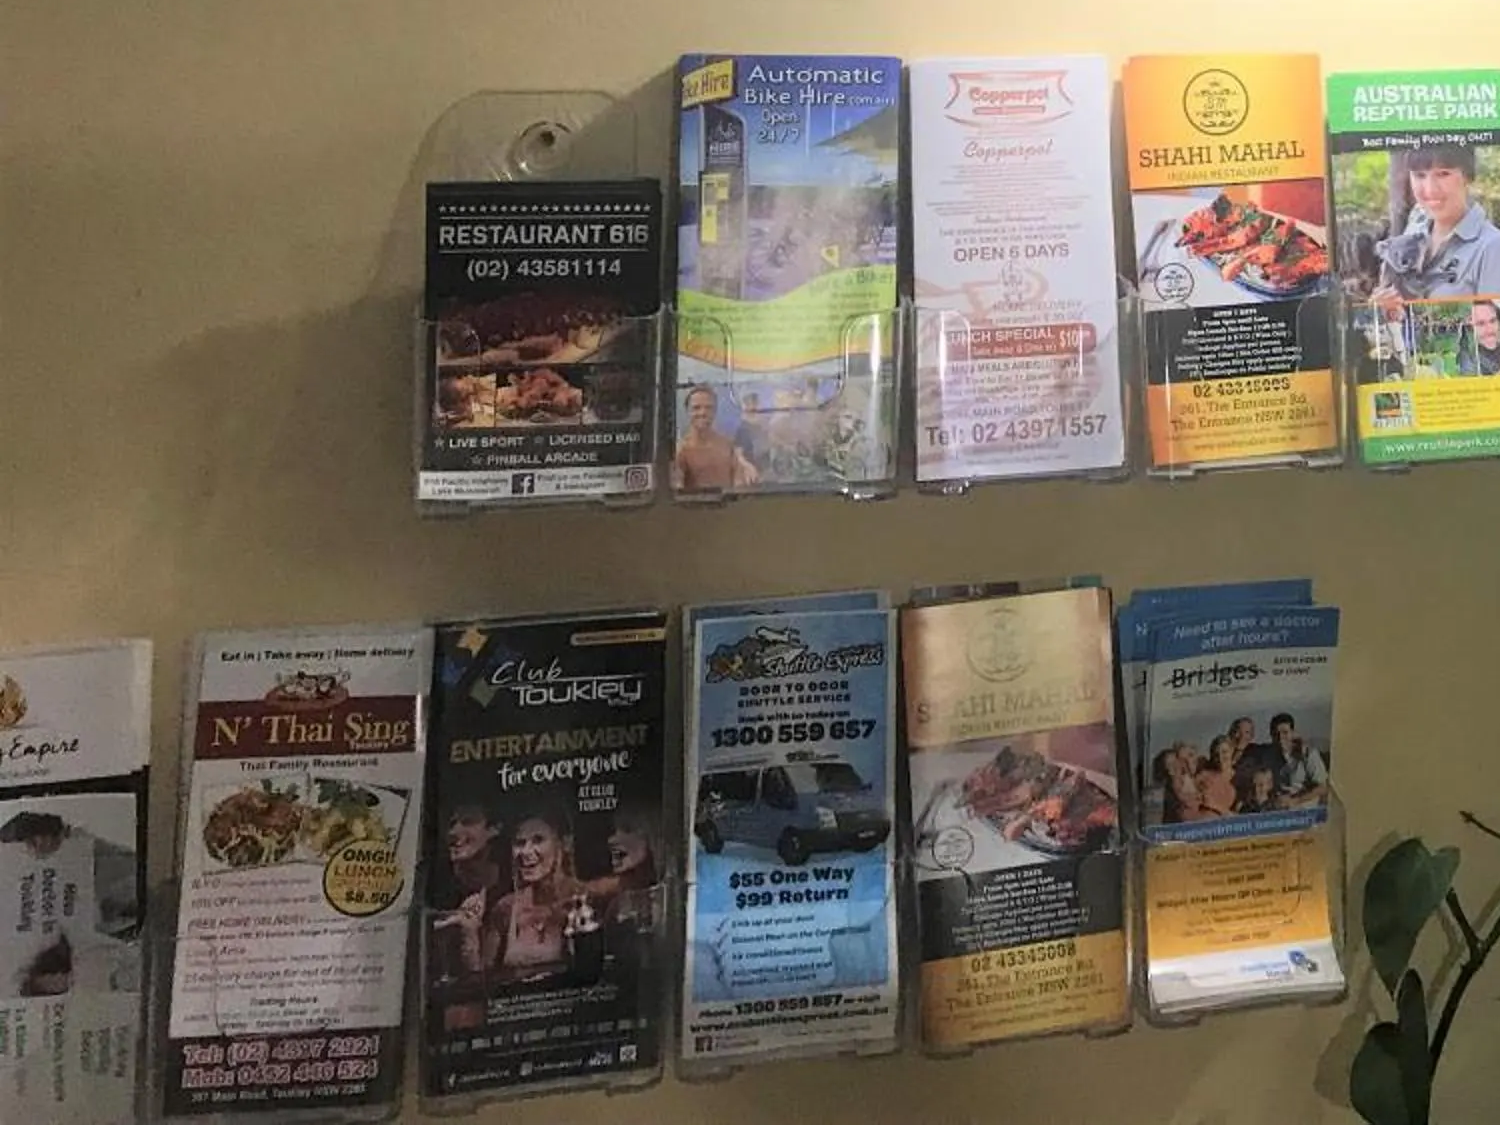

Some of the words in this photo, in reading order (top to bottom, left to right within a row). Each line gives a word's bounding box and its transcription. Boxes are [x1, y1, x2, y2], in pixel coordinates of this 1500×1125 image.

[749, 65, 884, 85] Automatic
[743, 87, 792, 105] Bike
[1353, 83, 1498, 105] AUSTRALIAN
[1352, 104, 1440, 123] REPTILE
[1443, 101, 1499, 120] PARK
[1139, 146, 1213, 168] SHAHI
[1219, 140, 1305, 164] MAHAL
[438, 225, 605, 246] RESTAURANT
[953, 245, 1004, 263] OPEN
[1024, 242, 1070, 258] DAYS
[467, 258, 510, 282] (02)
[516, 258, 622, 277] 43581114
[994, 327, 1056, 343] SPECIAL
[971, 423, 999, 444] 02
[491, 656, 563, 685] Club
[1172, 661, 1261, 690] Bridges
[785, 683, 805, 695] TO
[261, 714, 334, 744] Thai
[343, 712, 411, 746] Sing
[711, 726, 774, 748] 1300
[777, 722, 826, 743] 559
[450, 724, 648, 764] ENTERTAINMENT
[531, 750, 632, 784] everyone
[729, 872, 765, 890] $55
[769, 868, 809, 885] One
[812, 866, 855, 883] Way
[735, 891, 774, 911] $99
[778, 887, 849, 905] Return
